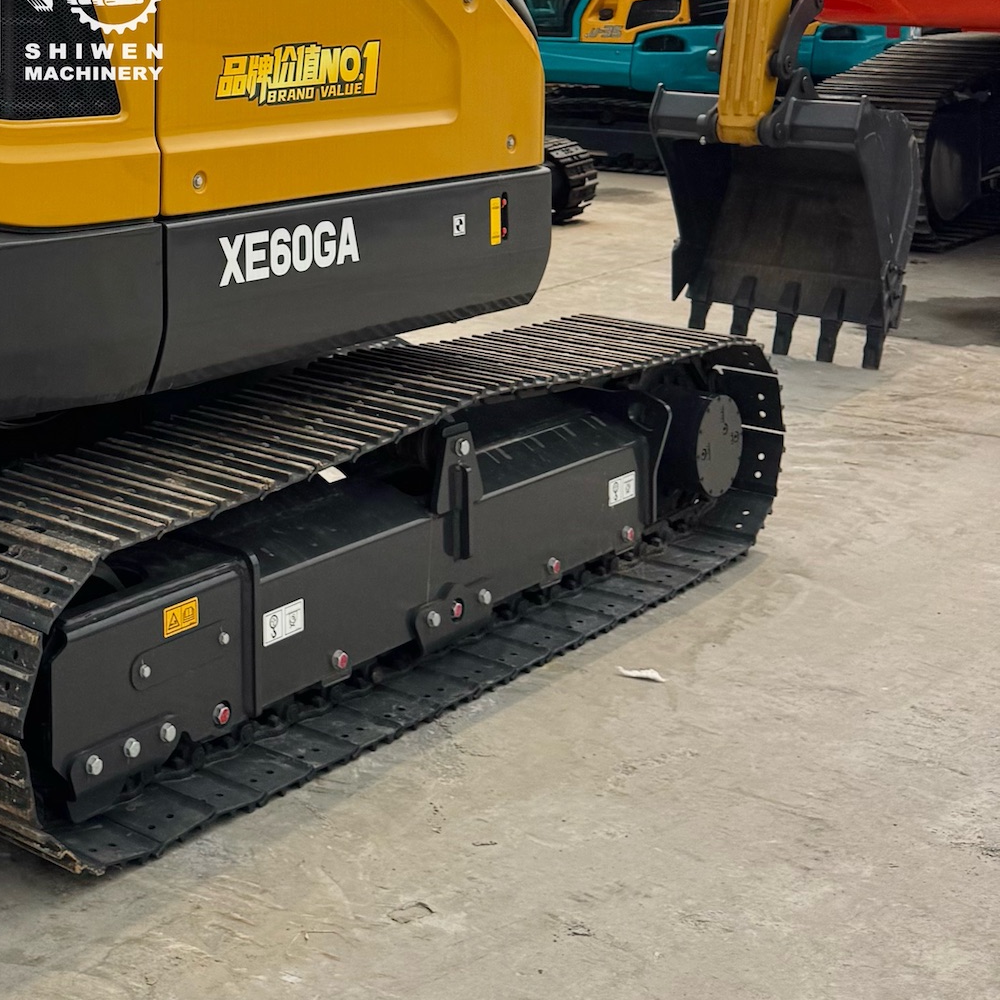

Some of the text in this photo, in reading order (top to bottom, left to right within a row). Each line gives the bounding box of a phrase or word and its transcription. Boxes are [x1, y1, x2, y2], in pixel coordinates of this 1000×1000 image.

[267, 83, 362, 104] BRAND VALUE
[218, 216, 361, 287] XE60GA
